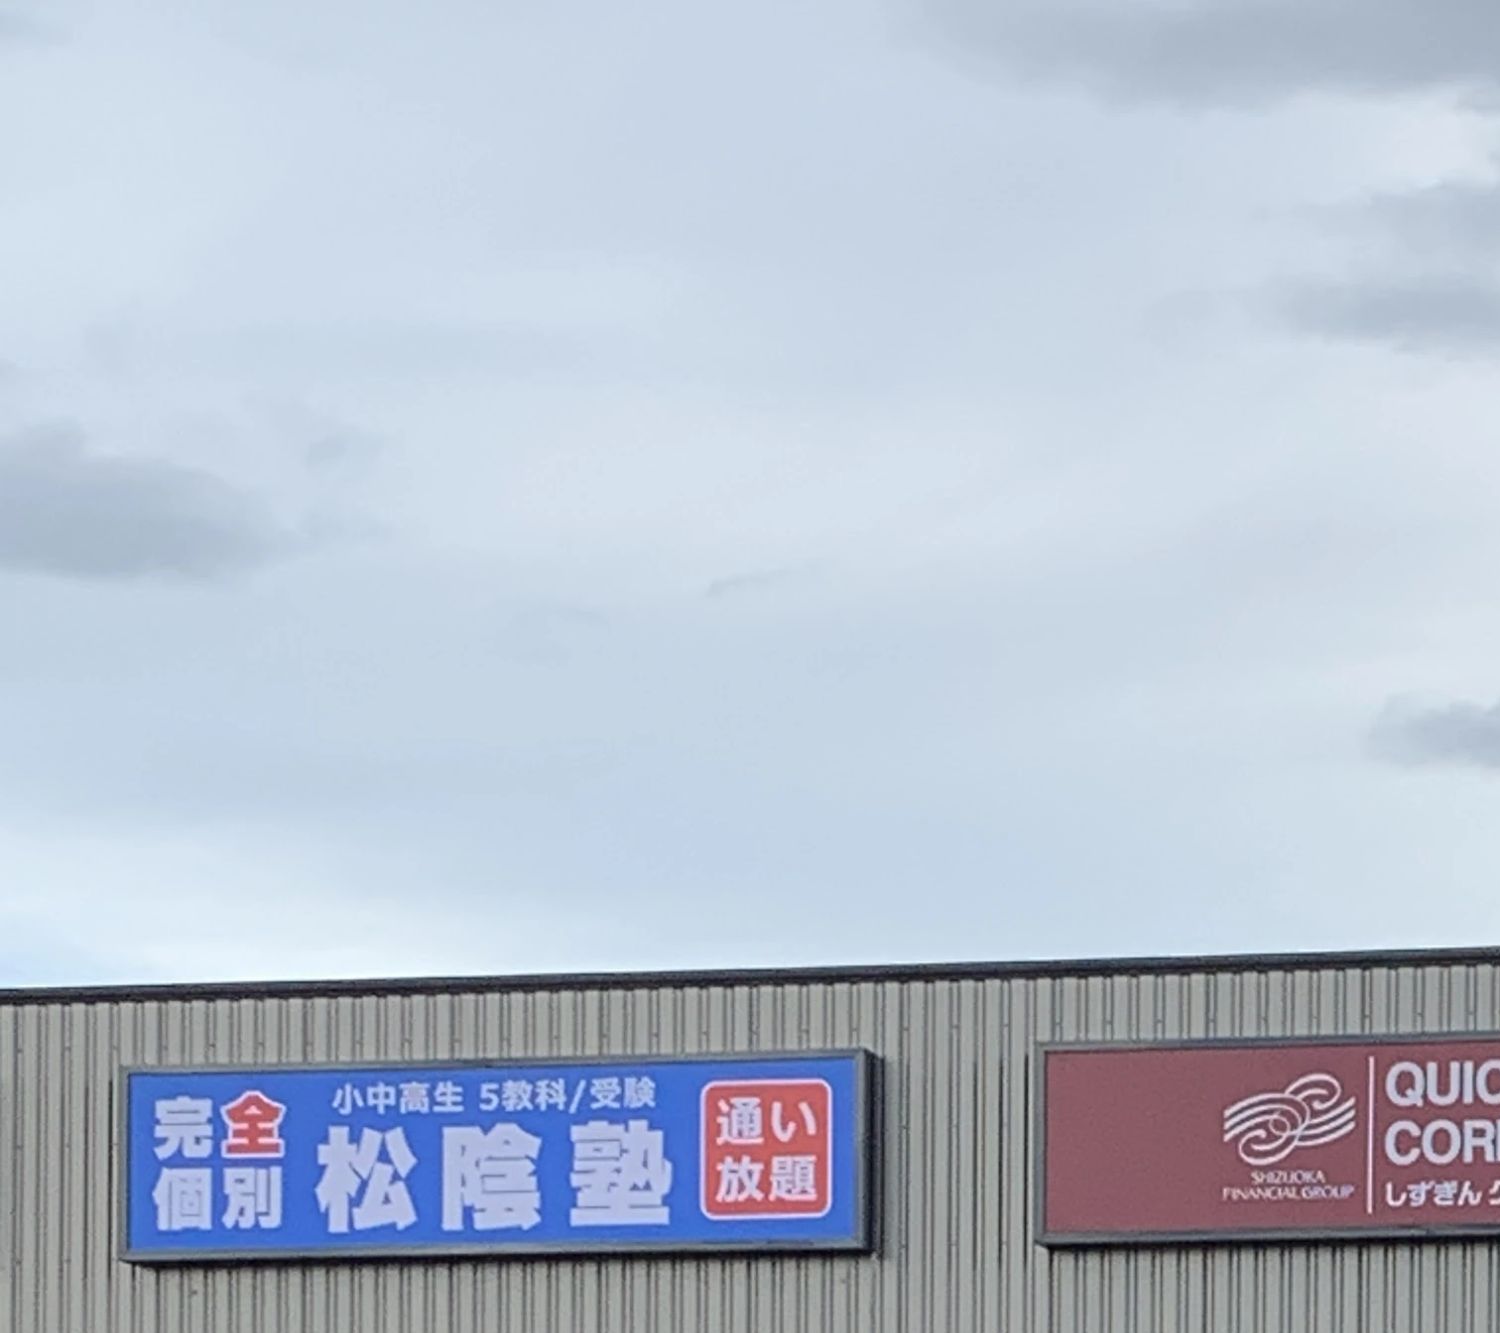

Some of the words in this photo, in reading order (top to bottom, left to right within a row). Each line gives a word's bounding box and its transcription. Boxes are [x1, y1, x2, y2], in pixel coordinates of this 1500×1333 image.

[332, 1081, 464, 1115] 小中高生
[479, 1076, 656, 1114] 5教科/受験
[154, 1090, 286, 1161] 完全
[715, 1096, 817, 1146] 通い
[152, 1166, 283, 1231] 個別
[315, 1119, 672, 1233] 松陰塾
[715, 1154, 818, 1202] 放題
[1222, 1185, 1300, 1201] FINANCIAL
[1301, 1184, 1355, 1200] GROUP
[1250, 1169, 1326, 1185] SHIZUOKA
[1385, 1179, 1482, 1208] しずぎん
